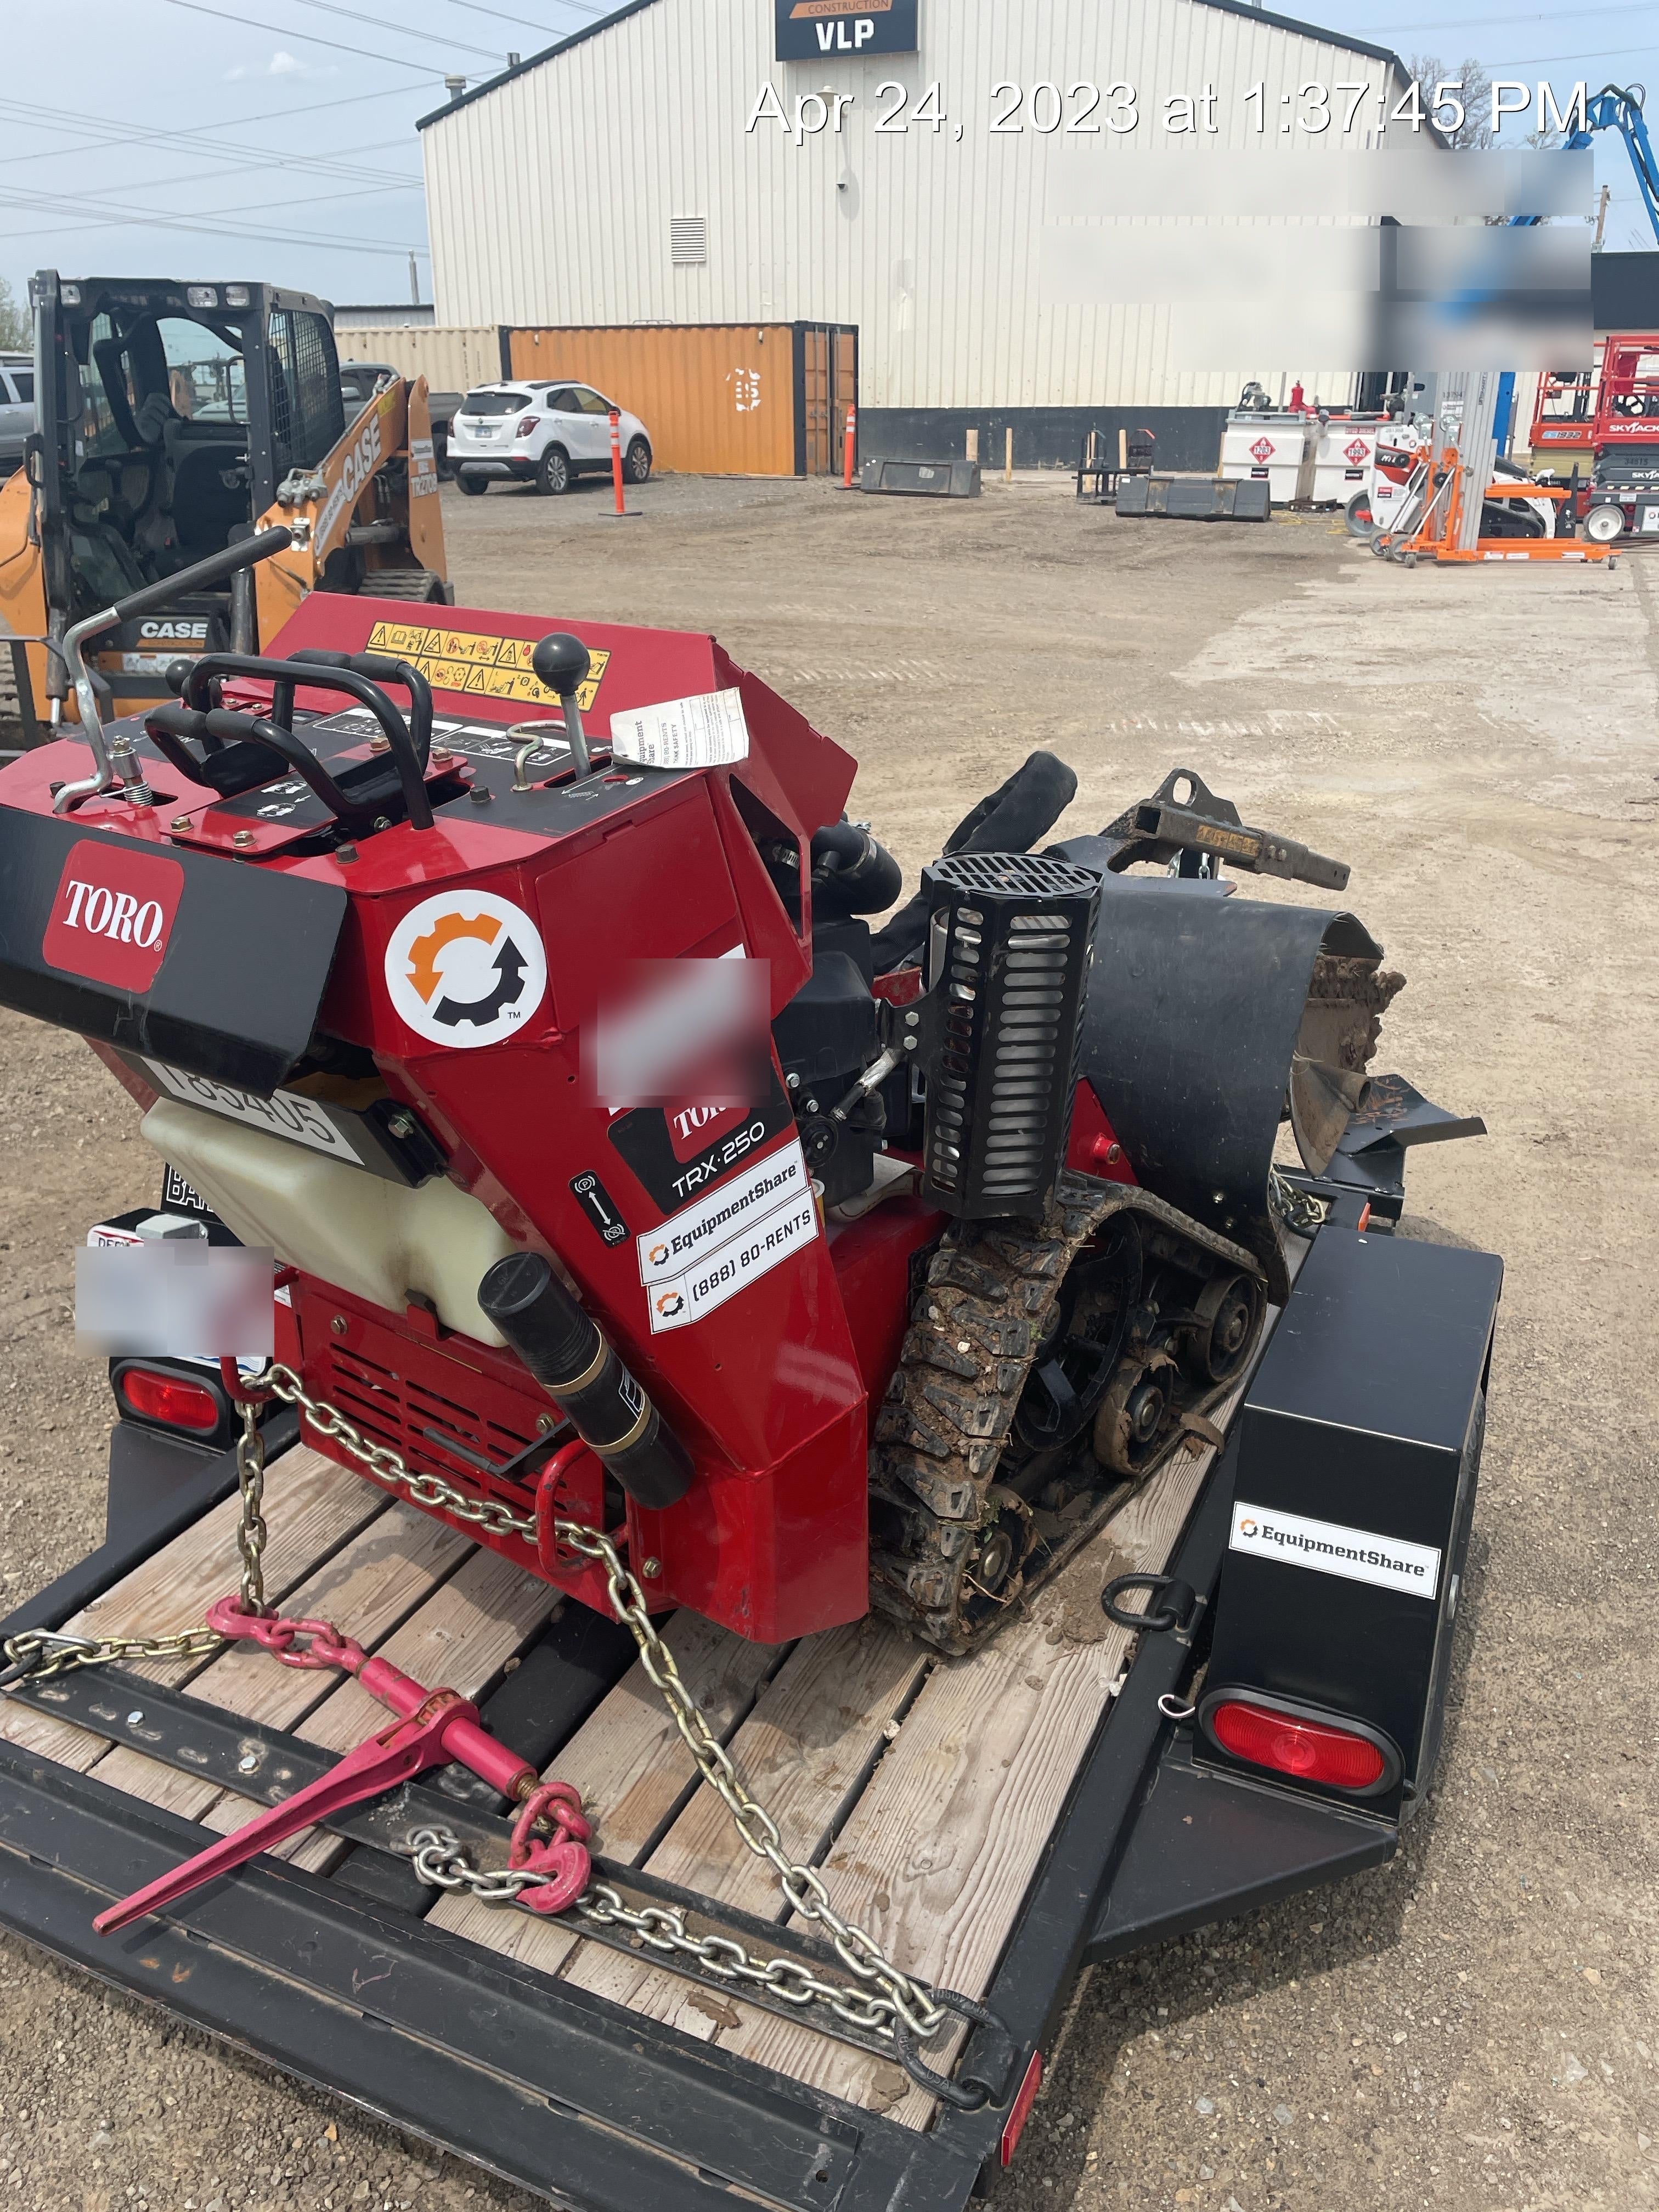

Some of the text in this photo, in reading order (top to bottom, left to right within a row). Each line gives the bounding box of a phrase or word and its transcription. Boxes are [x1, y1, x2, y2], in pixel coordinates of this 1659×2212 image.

[808, 0, 889, 14] CONSTRUCTION
[815, 19, 874, 52] VLP
[342, 413, 382, 501] CASE
[1349, 448, 1364, 456] 1993
[140, 622, 208, 638] CASE
[635, 720, 646, 763] quipment
[671, 724, 679, 749] SAFETY
[63, 881, 162, 947] TORO
[673, 1108, 726, 1140] TO
[166, 1166, 215, 1213] BA
[670, 1164, 797, 1255] EquipmentShare
[692, 1209, 811, 1302] (888) 80-RENTS
[1261, 1525, 1425, 1577] EquipmentShare
[926, 2070, 950, 2090] USA
